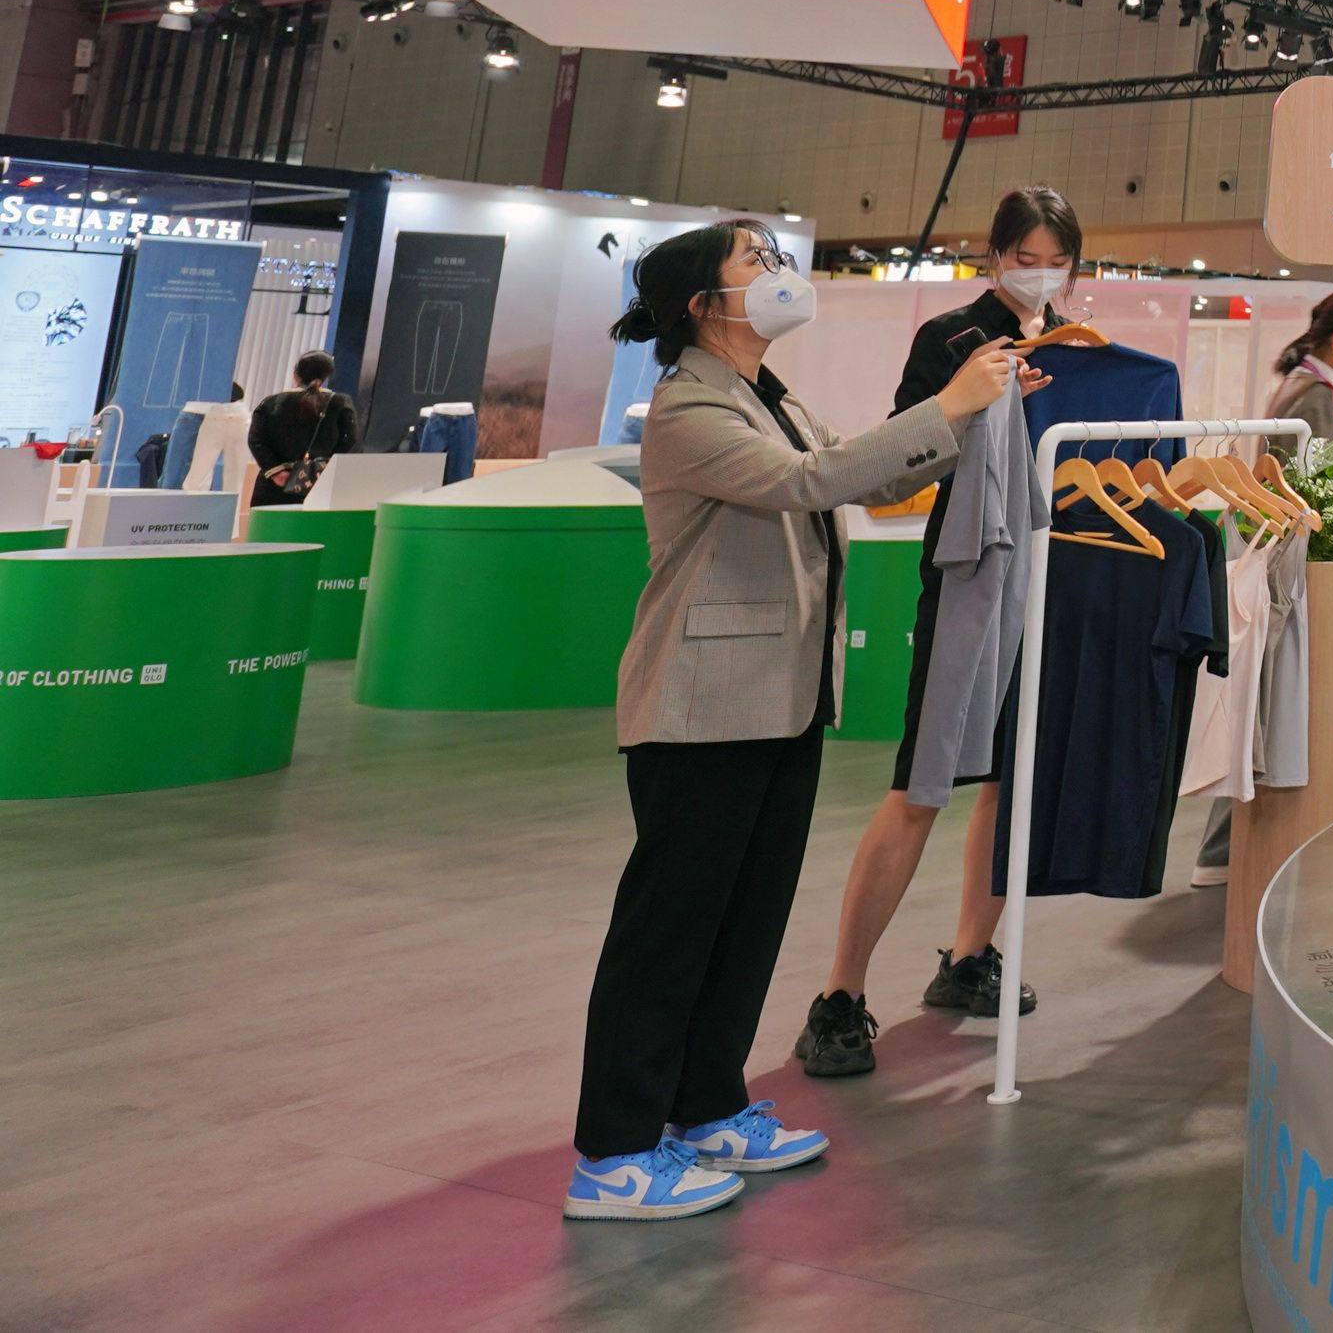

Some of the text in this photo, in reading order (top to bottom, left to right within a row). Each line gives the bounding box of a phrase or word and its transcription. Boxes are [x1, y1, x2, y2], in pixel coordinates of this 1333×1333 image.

[131, 523, 209, 533] UV PROTECTION
[228, 657, 260, 675] THE
[6, 670, 29, 686] OF
[32, 668, 133, 686] CLOTHING
